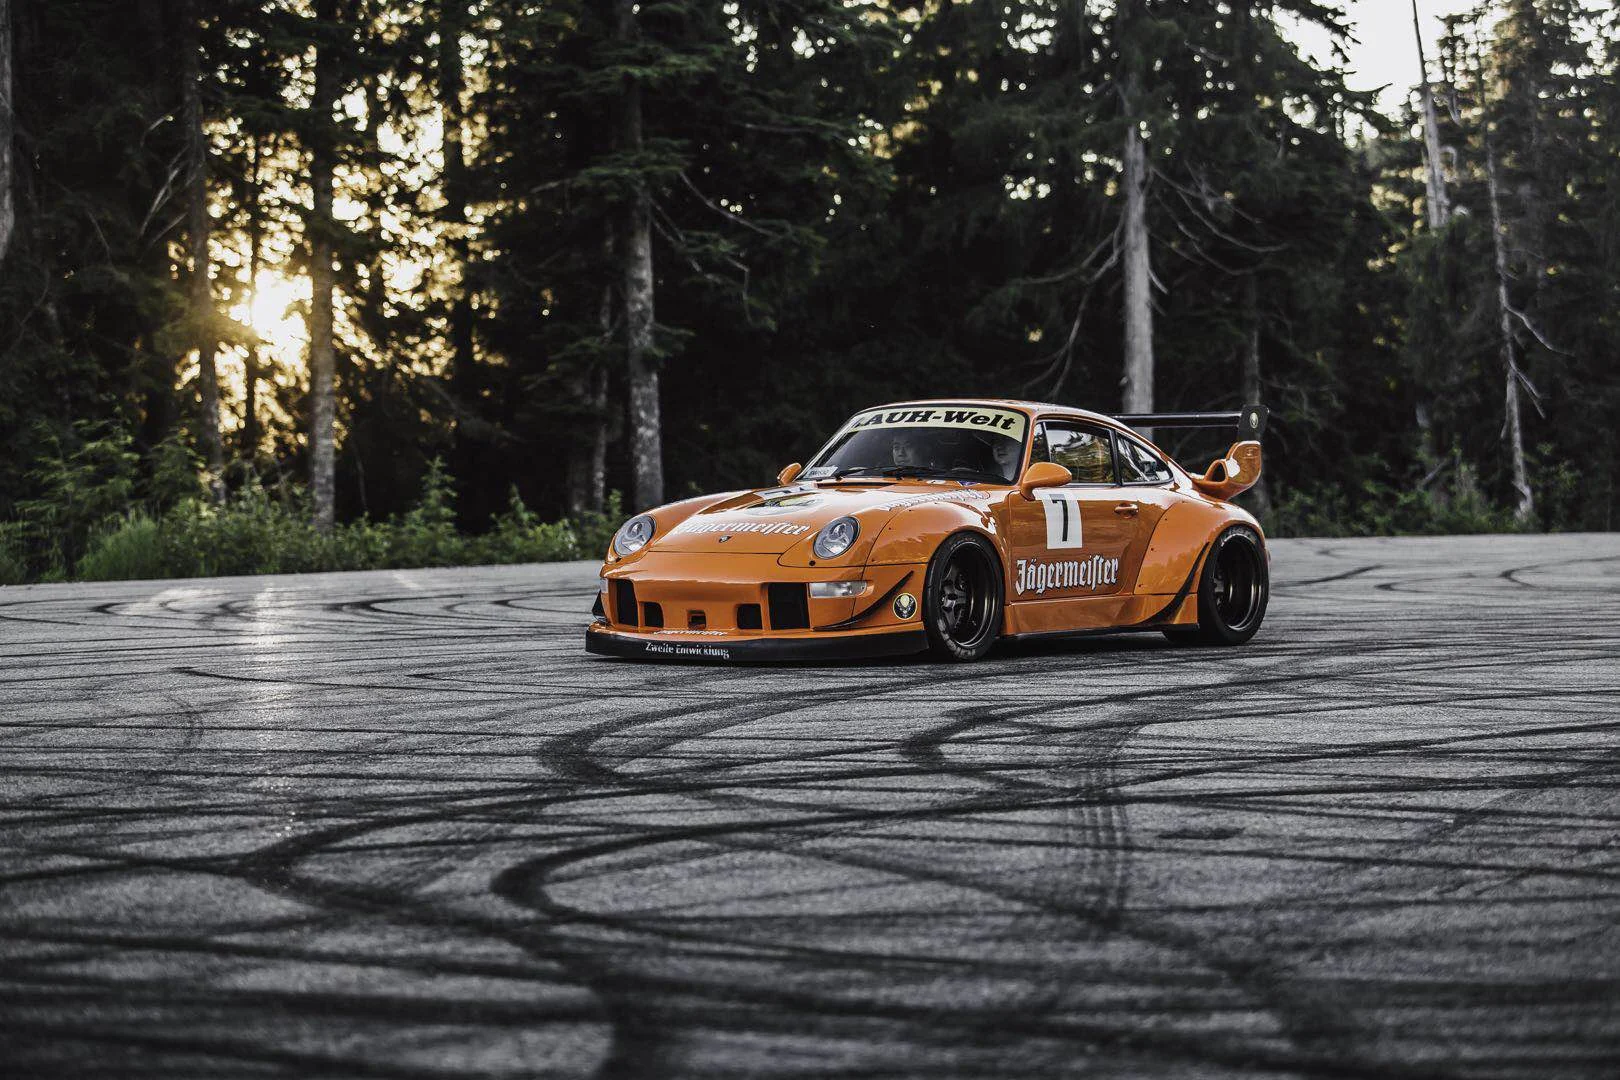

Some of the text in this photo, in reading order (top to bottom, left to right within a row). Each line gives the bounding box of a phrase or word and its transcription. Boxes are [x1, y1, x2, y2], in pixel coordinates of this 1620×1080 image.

[676, 521, 809, 536] ägermeister
[1049, 494, 1069, 542] 7
[1015, 555, 1119, 596] Jägermeister
